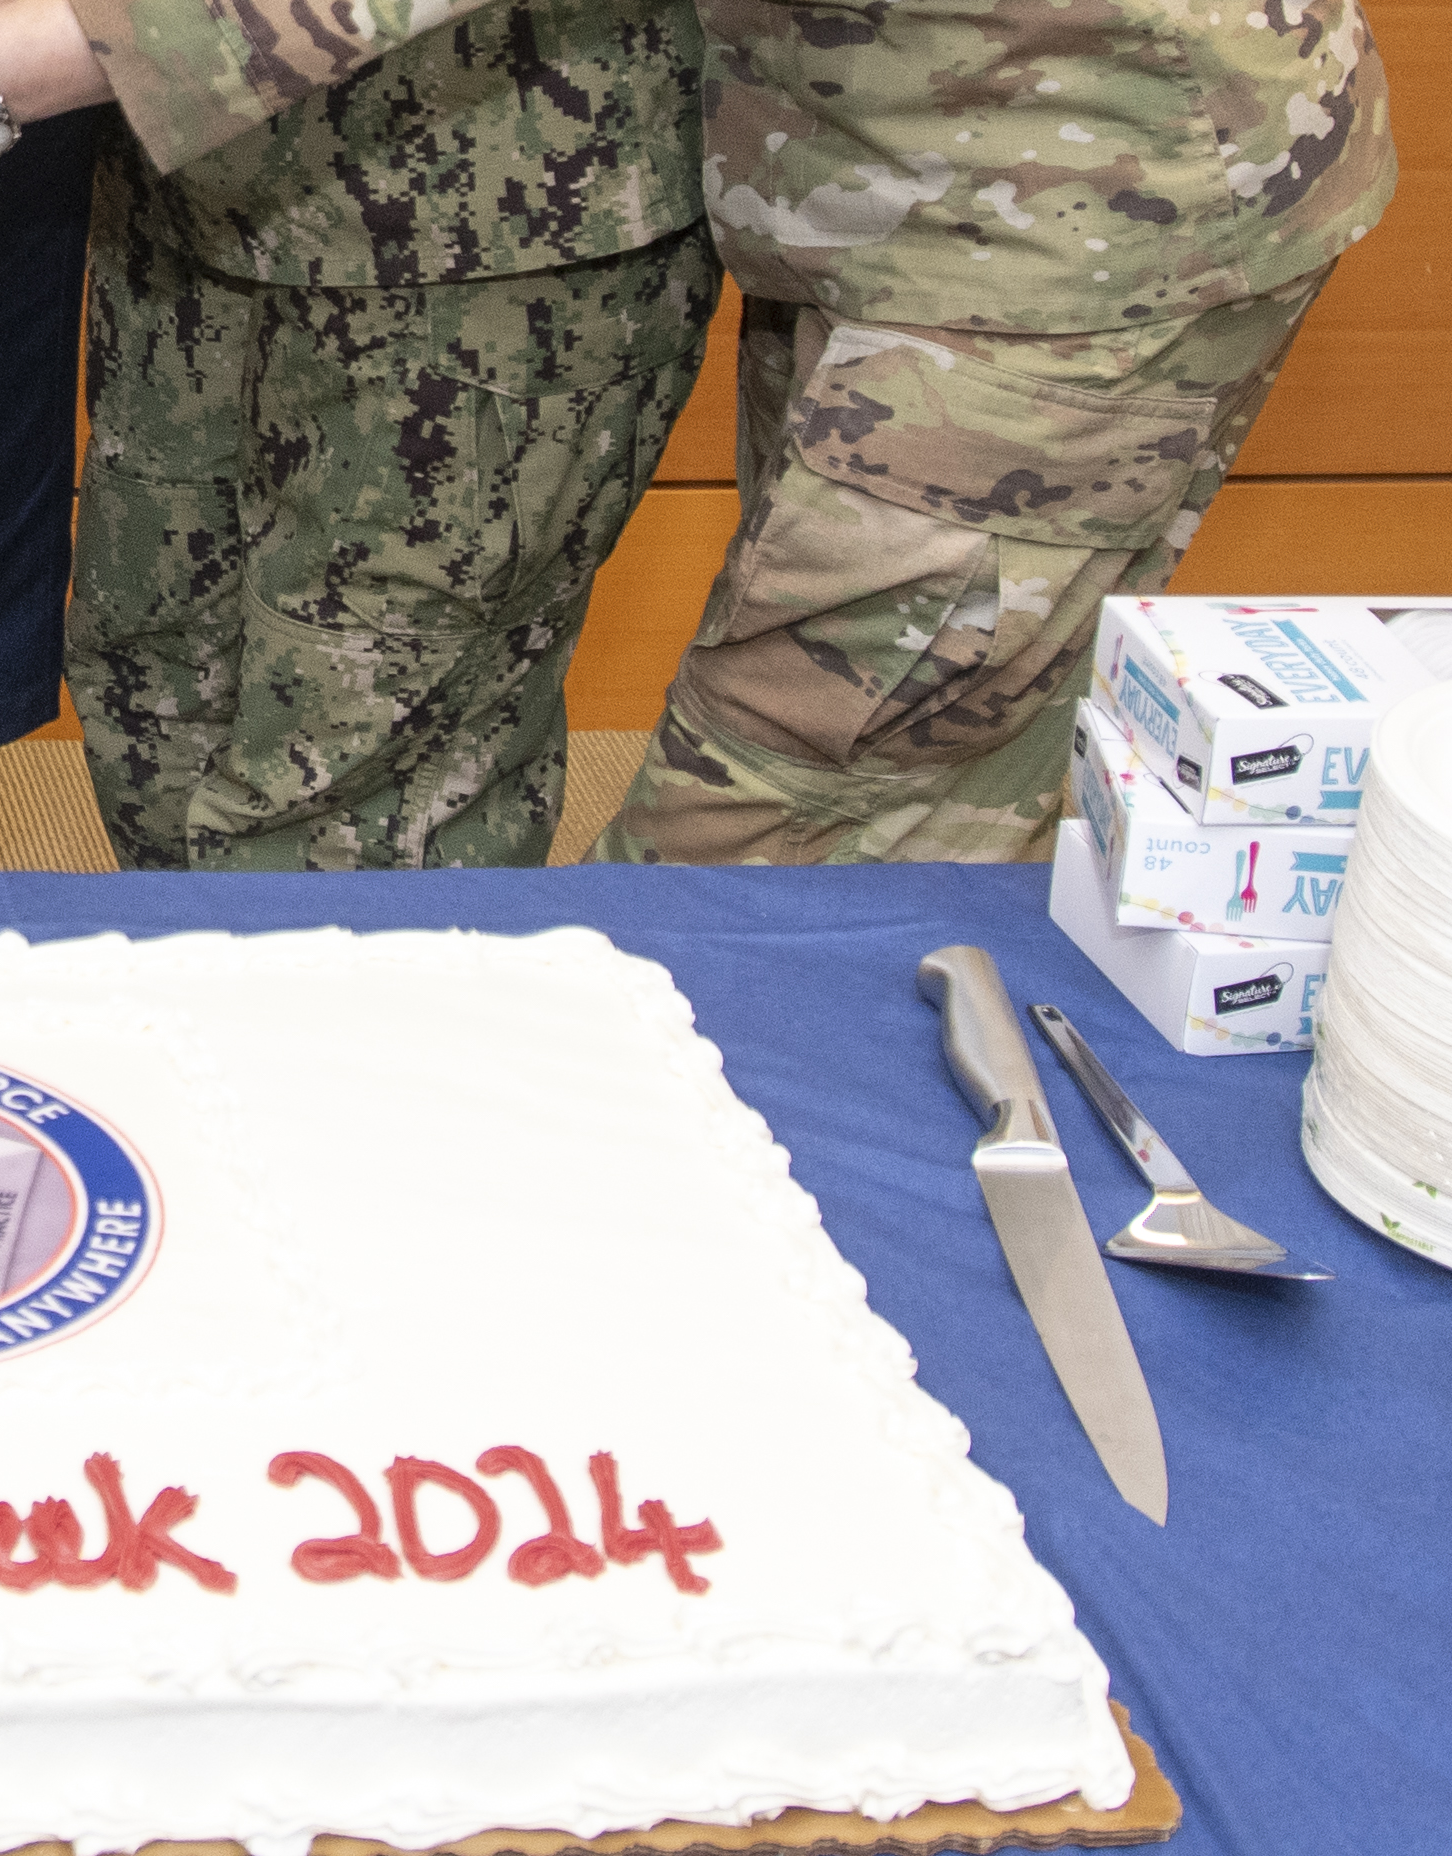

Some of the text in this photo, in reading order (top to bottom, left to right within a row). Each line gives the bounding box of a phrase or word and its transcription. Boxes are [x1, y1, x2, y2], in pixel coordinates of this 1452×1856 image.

[1225, 619, 1342, 704] EVERYDAY
[1144, 856, 1173, 872] 48
[1146, 837, 1212, 855] count
[267, 1443, 723, 1595] 2024
